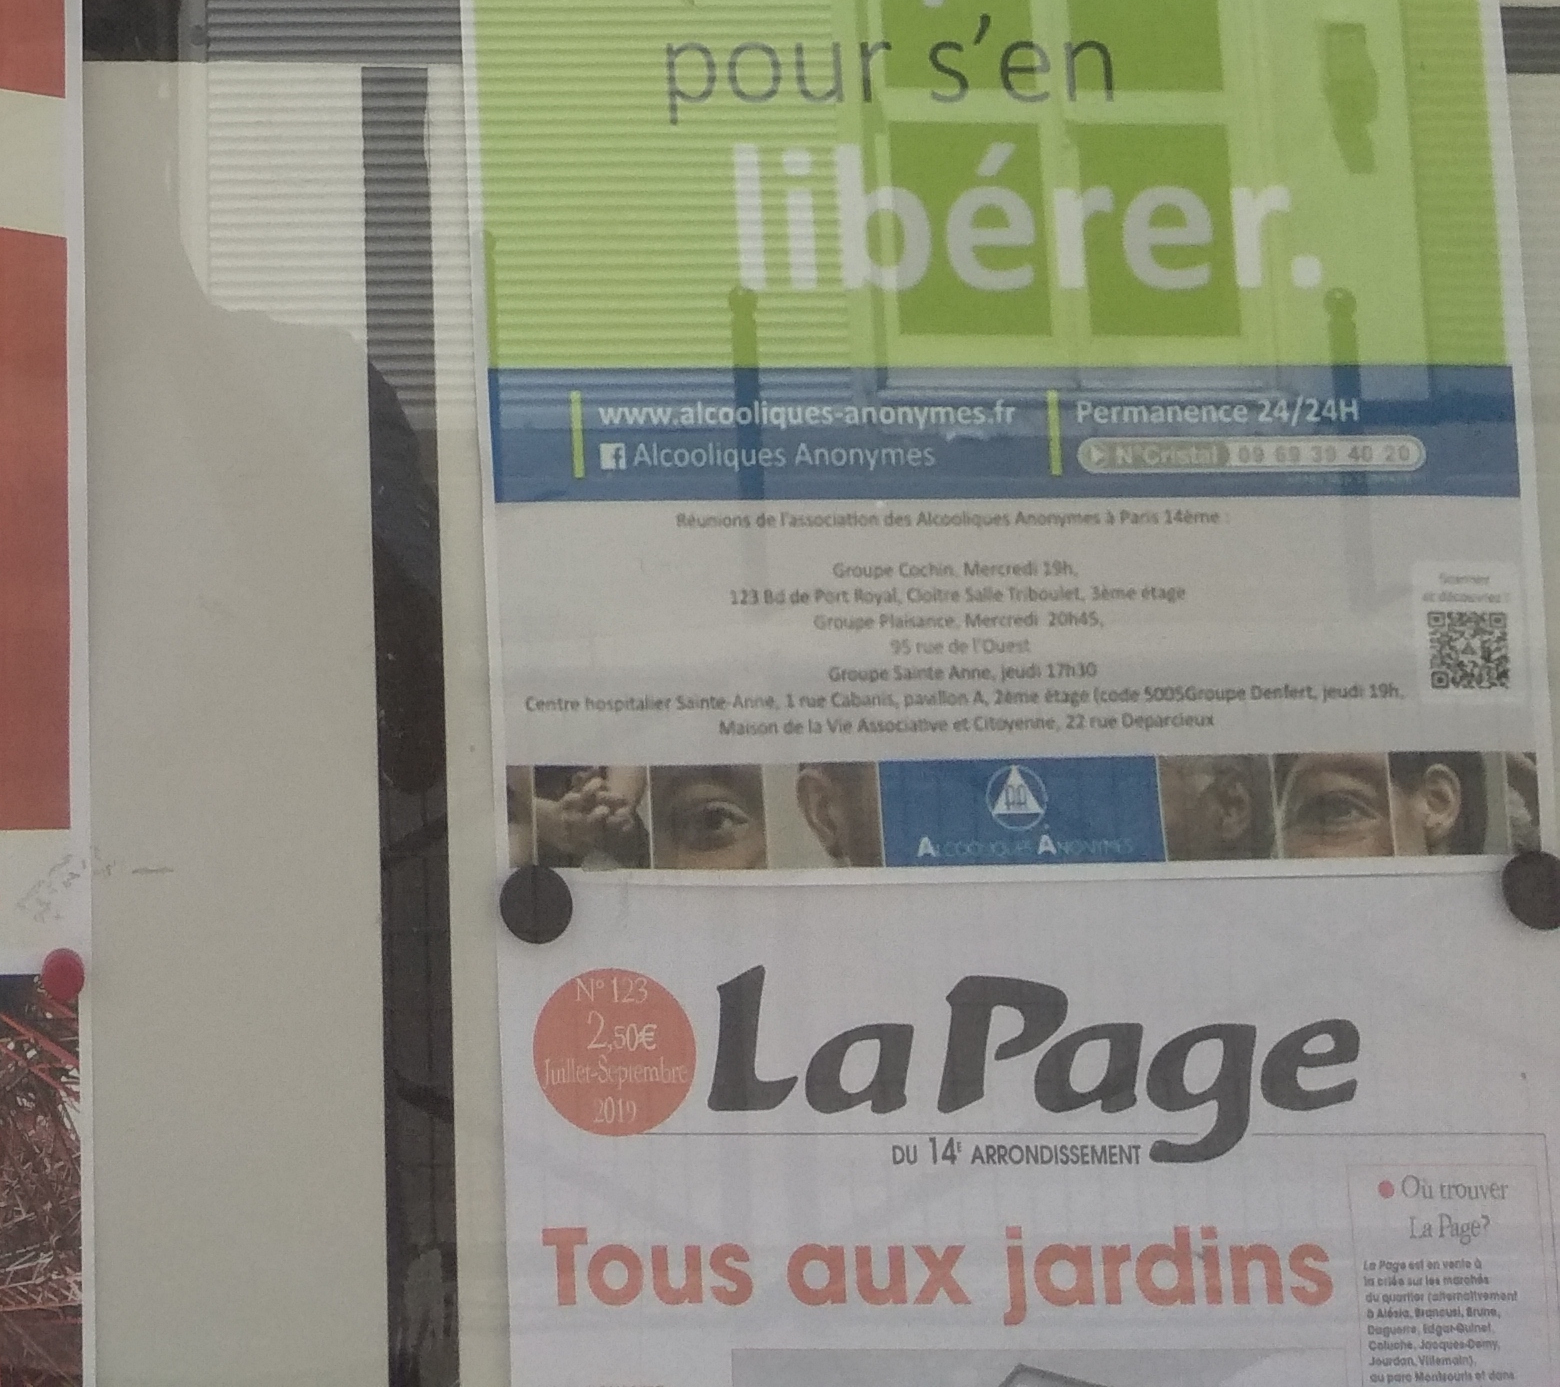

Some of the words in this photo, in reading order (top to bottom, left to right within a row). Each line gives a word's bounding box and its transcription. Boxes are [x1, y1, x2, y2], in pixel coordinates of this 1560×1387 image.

[665, 38, 893, 125] pour
[928, 13, 1117, 105] s'en
[731, 142, 1323, 292] libérer.
[599, 400, 1017, 430] www.alcooliques-anonymes.fr
[1076, 400, 1250, 427] Permanence
[1258, 398, 1361, 426] 24/24H
[633, 442, 787, 471] Alcooliques
[795, 442, 937, 471] Anonymes
[970, 1144, 1141, 1165] ARRONDISSEMENT
[1440, 1183, 1509, 1200] trouver
[542, 1225, 754, 1308] Tous
[786, 1242, 972, 1307] aux
[1000, 1223, 1336, 1326] jardins
